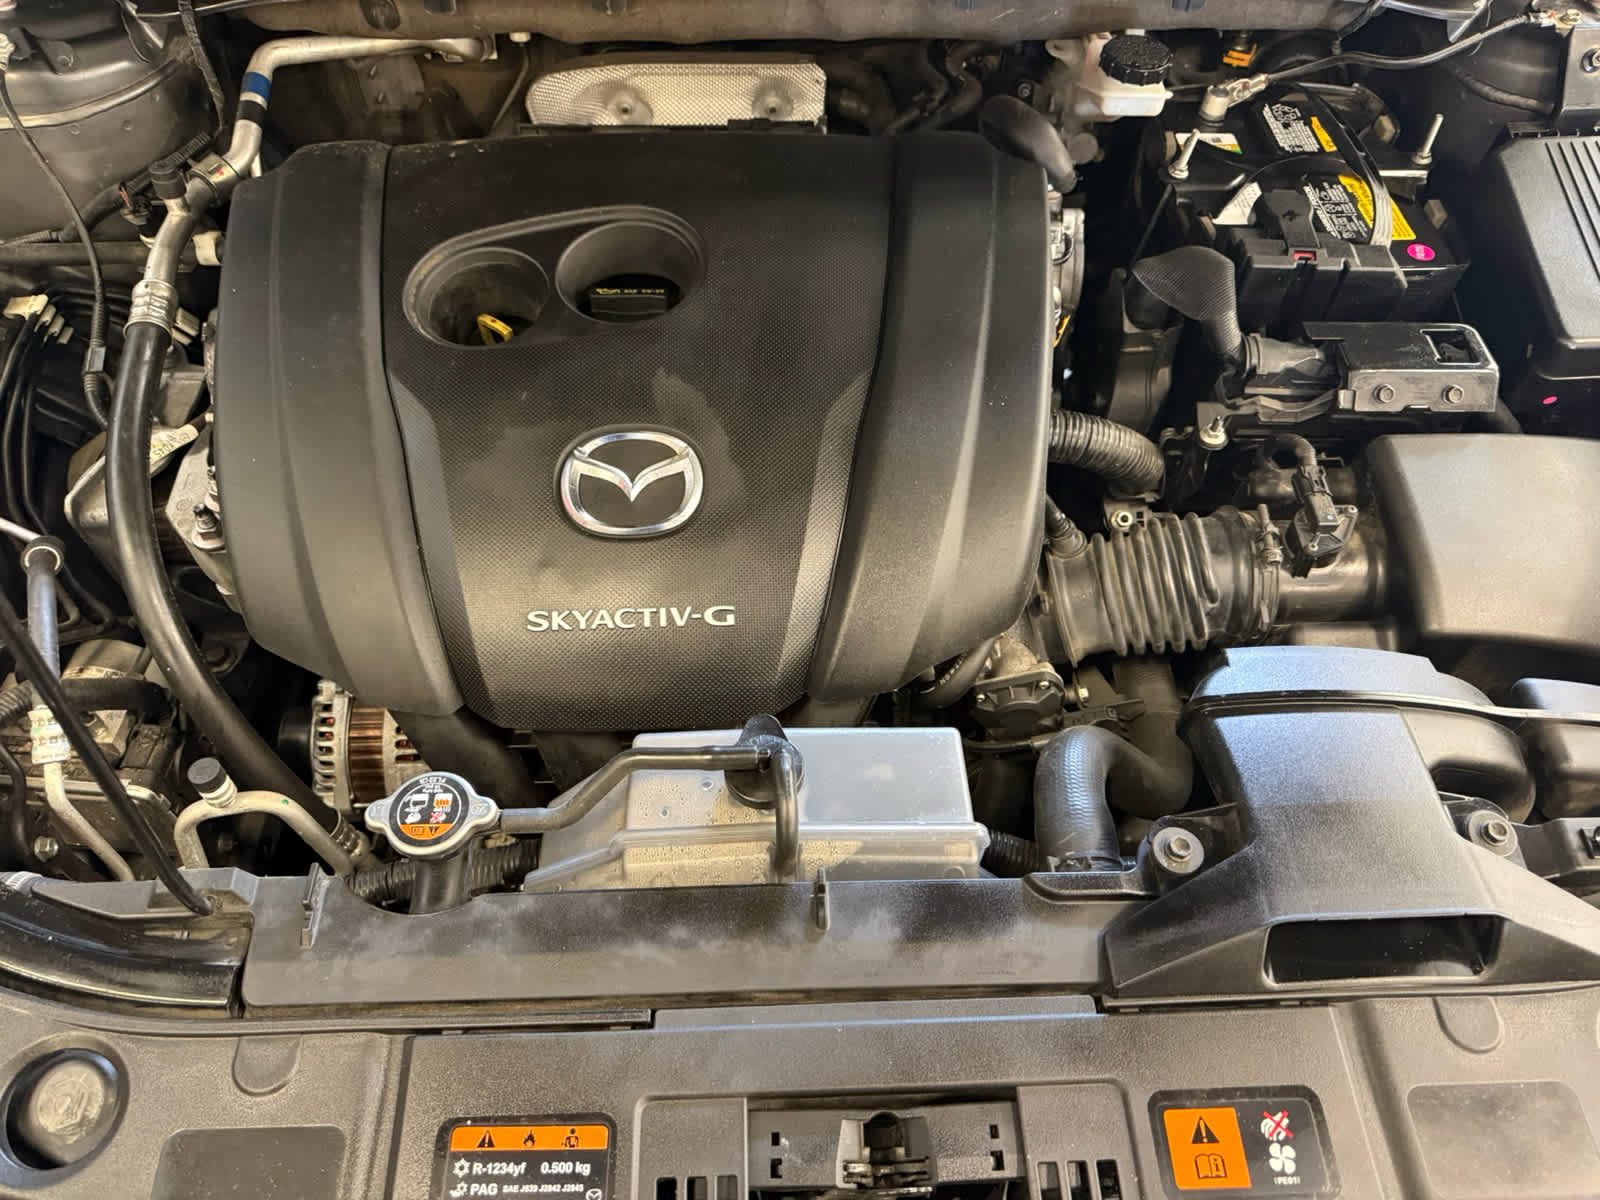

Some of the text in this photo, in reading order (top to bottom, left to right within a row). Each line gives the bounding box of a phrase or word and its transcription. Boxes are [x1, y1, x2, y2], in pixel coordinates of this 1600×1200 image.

[526, 604, 736, 632] SKYACTIV-G
[472, 1160, 591, 1176] R-1234yf 0.500 kg
[470, 1182, 498, 1196] PAG
